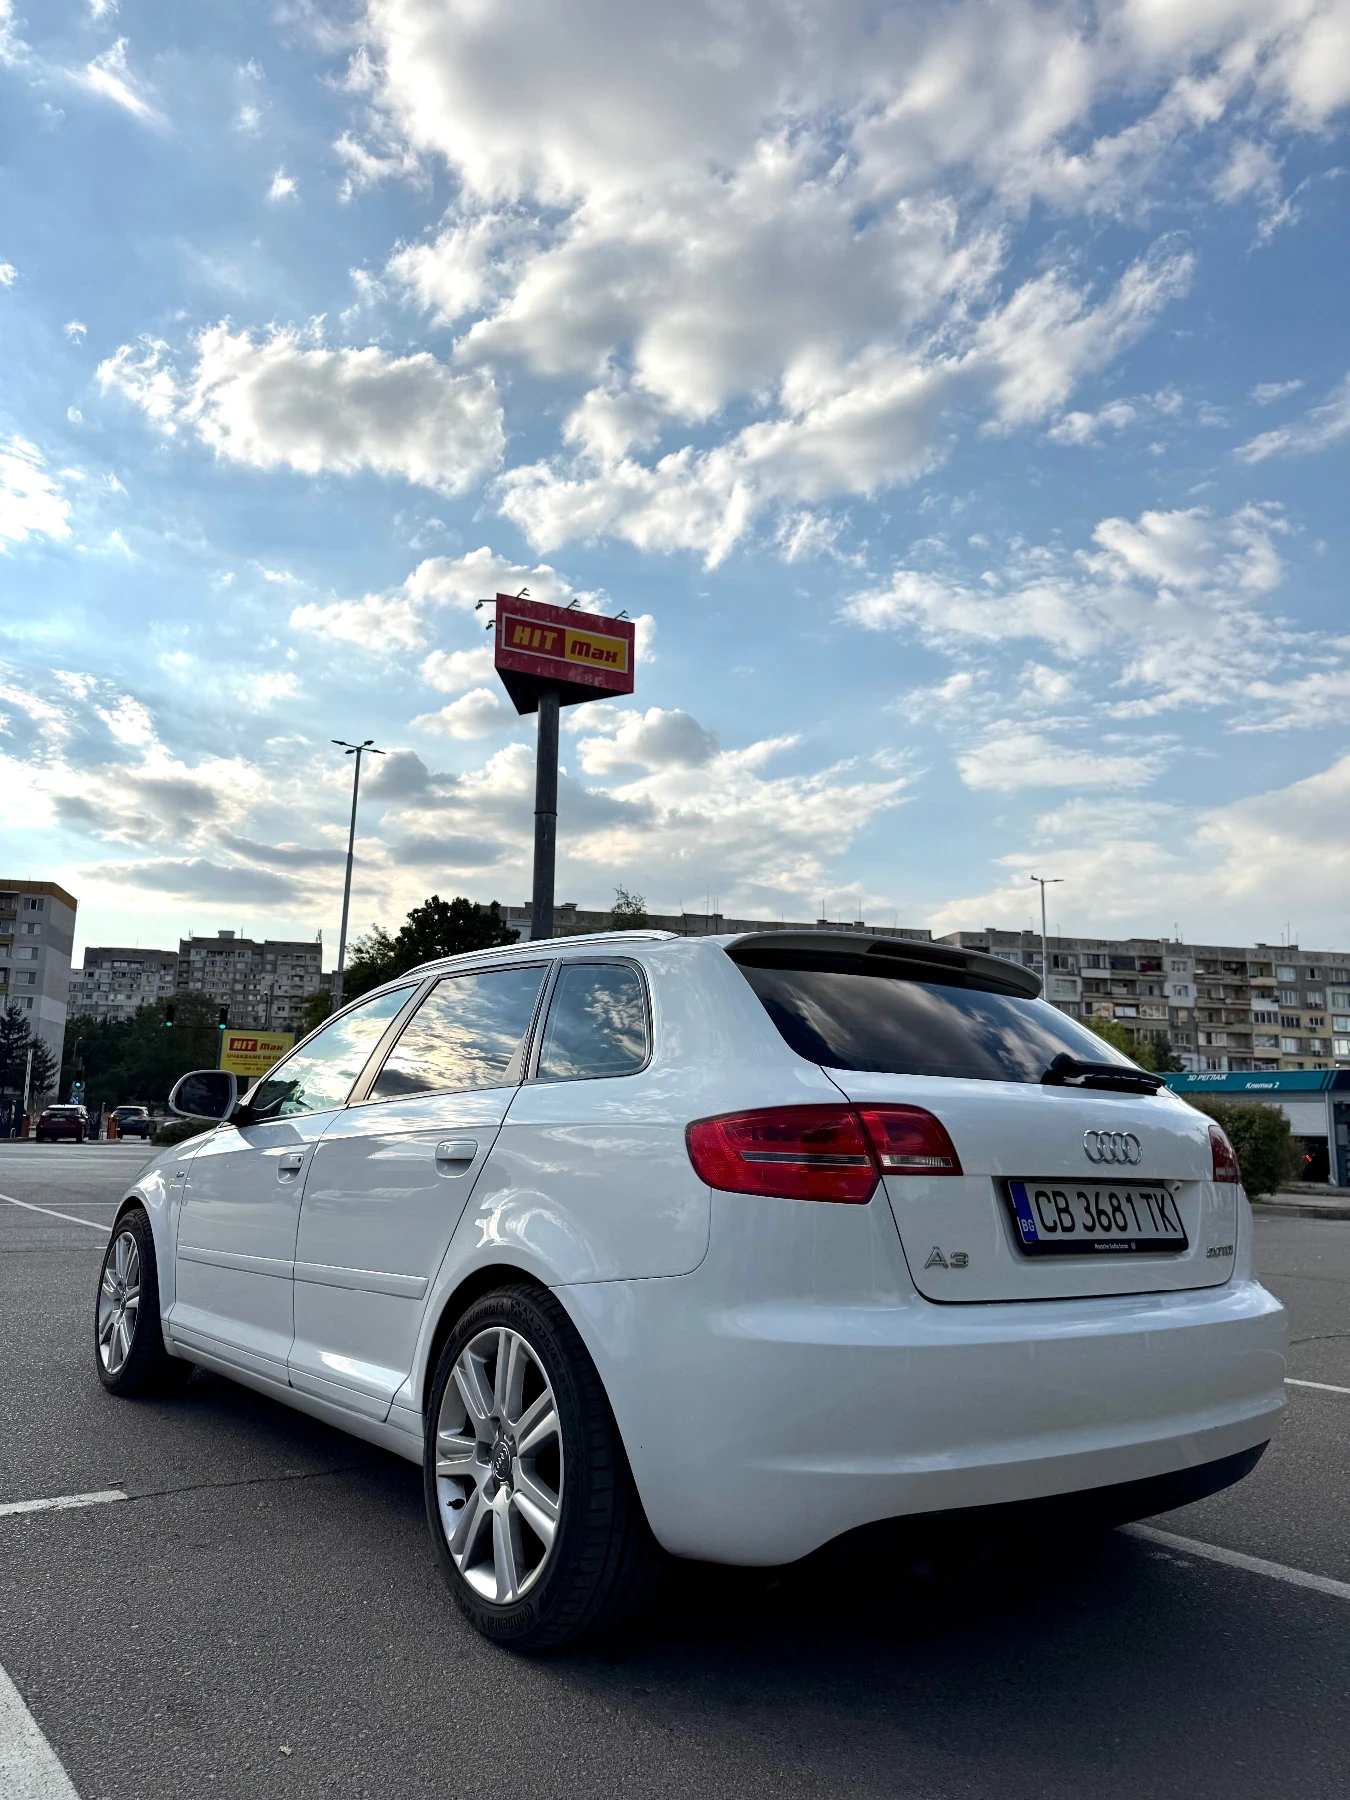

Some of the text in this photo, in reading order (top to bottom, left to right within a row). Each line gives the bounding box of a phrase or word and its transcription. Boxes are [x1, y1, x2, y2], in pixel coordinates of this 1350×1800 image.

[512, 625, 558, 650] HIT
[232, 1040, 255, 1050] HIT
[1197, 1073, 1228, 1081] РЕГЛАЖ
[1273, 1081, 1280, 1089] 2
[1021, 1219, 1035, 1232] BG
[924, 1245, 969, 1269] A3
